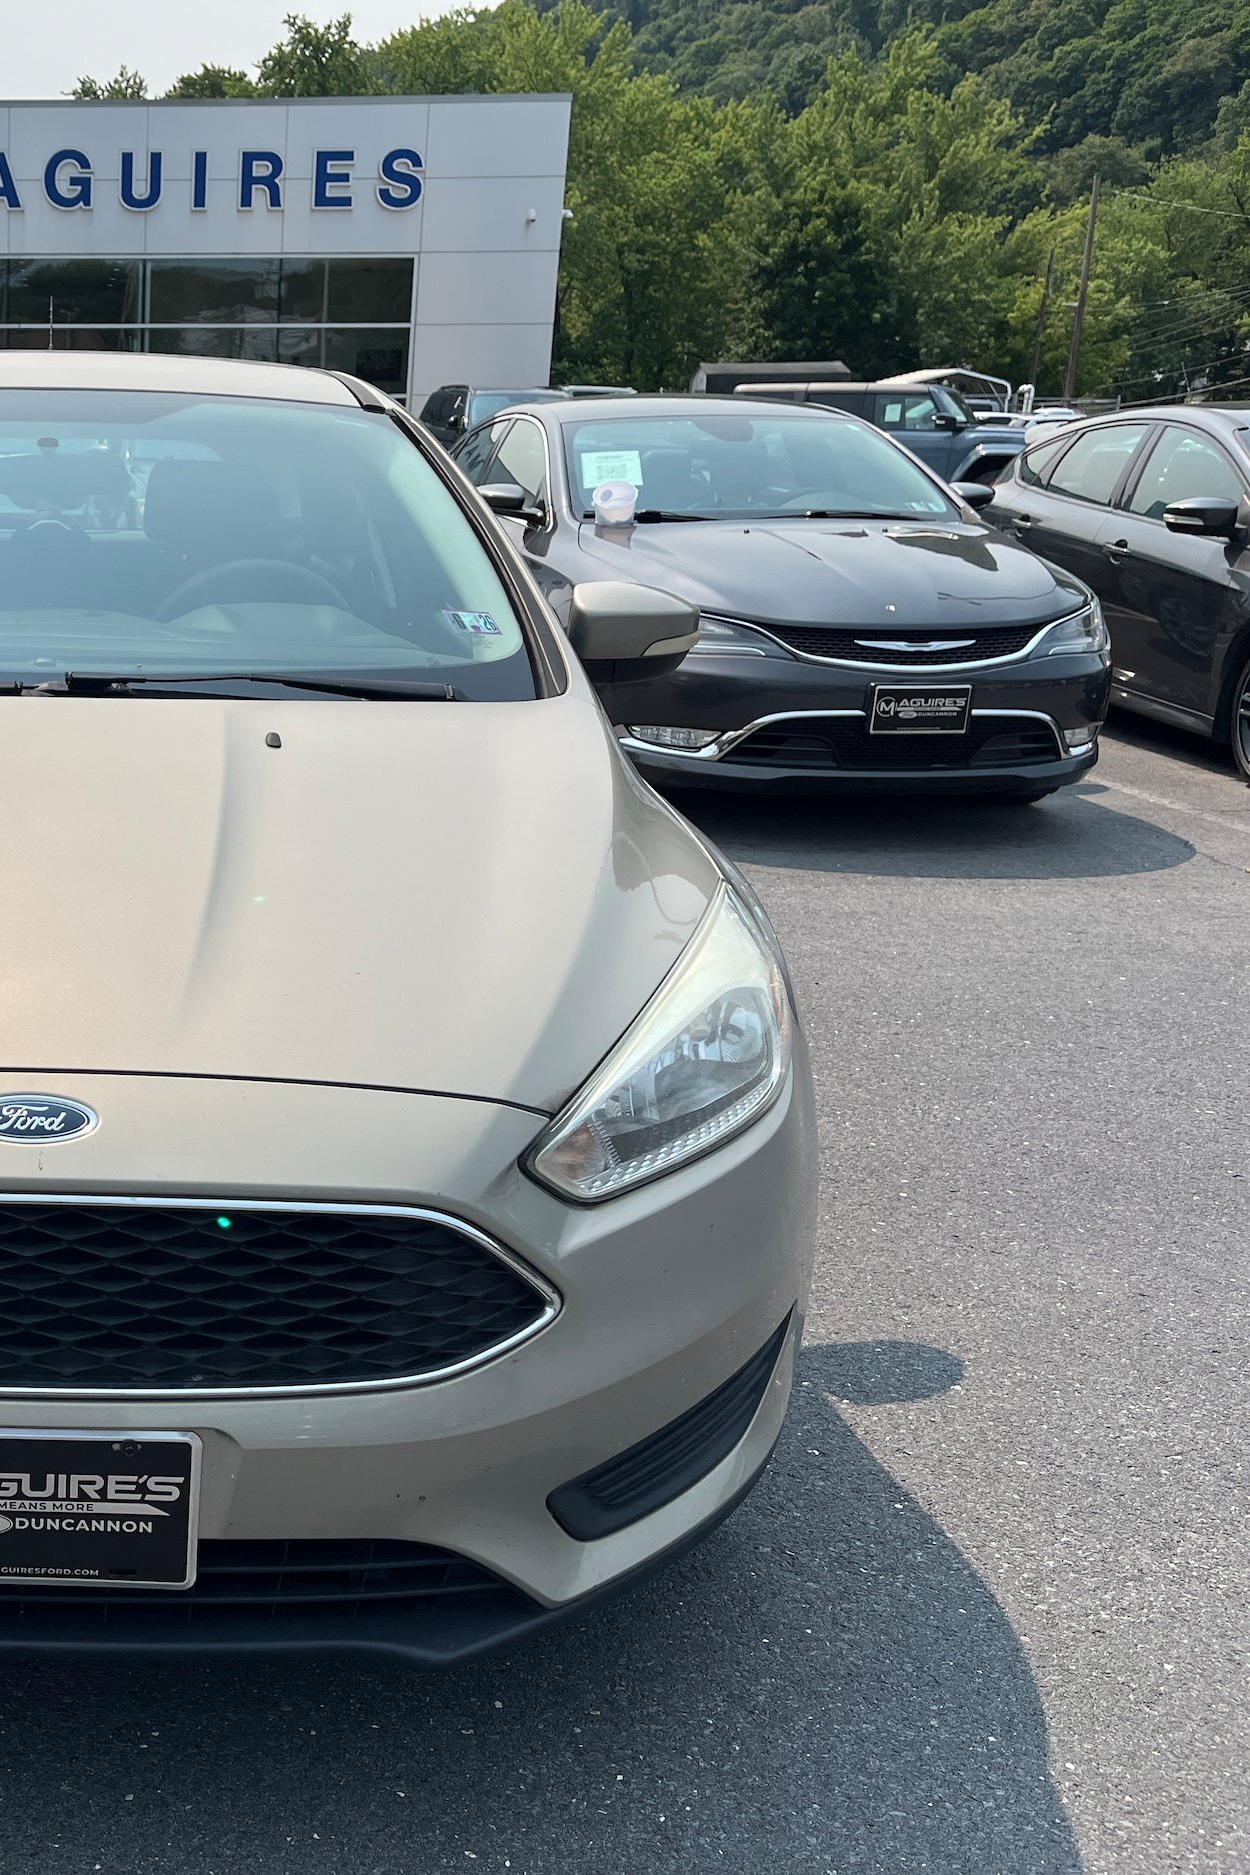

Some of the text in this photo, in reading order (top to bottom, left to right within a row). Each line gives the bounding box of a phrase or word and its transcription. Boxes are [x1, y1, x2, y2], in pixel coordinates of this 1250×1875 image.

[478, 614, 497, 631] 26
[52, 1502, 94, 1512] MORE
[14, 1518, 153, 1534] DUNCANNON
